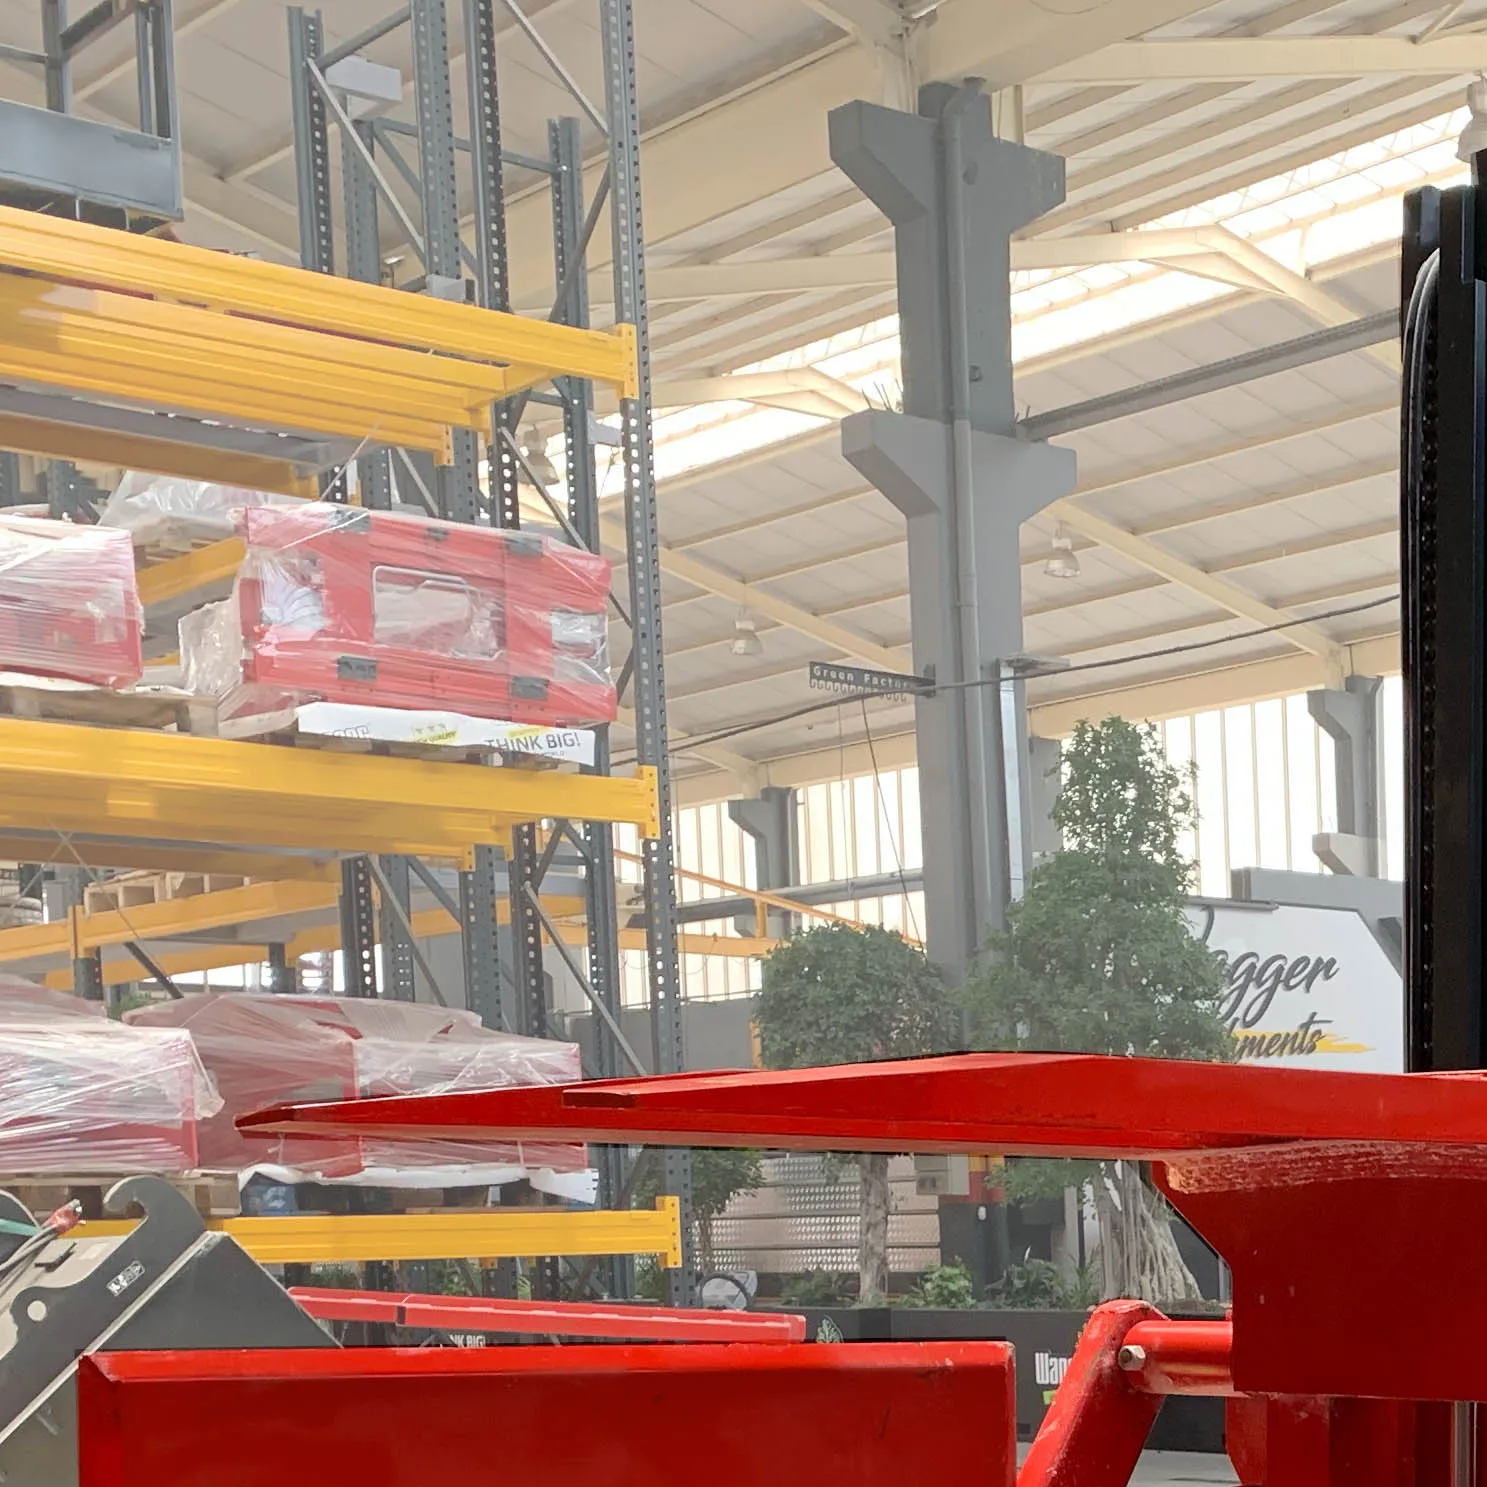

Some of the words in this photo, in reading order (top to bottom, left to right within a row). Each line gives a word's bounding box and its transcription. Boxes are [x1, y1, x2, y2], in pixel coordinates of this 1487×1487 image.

[813, 665, 854, 681] Green
[484, 734, 543, 752] THINK
[546, 731, 581, 749] BIG!
